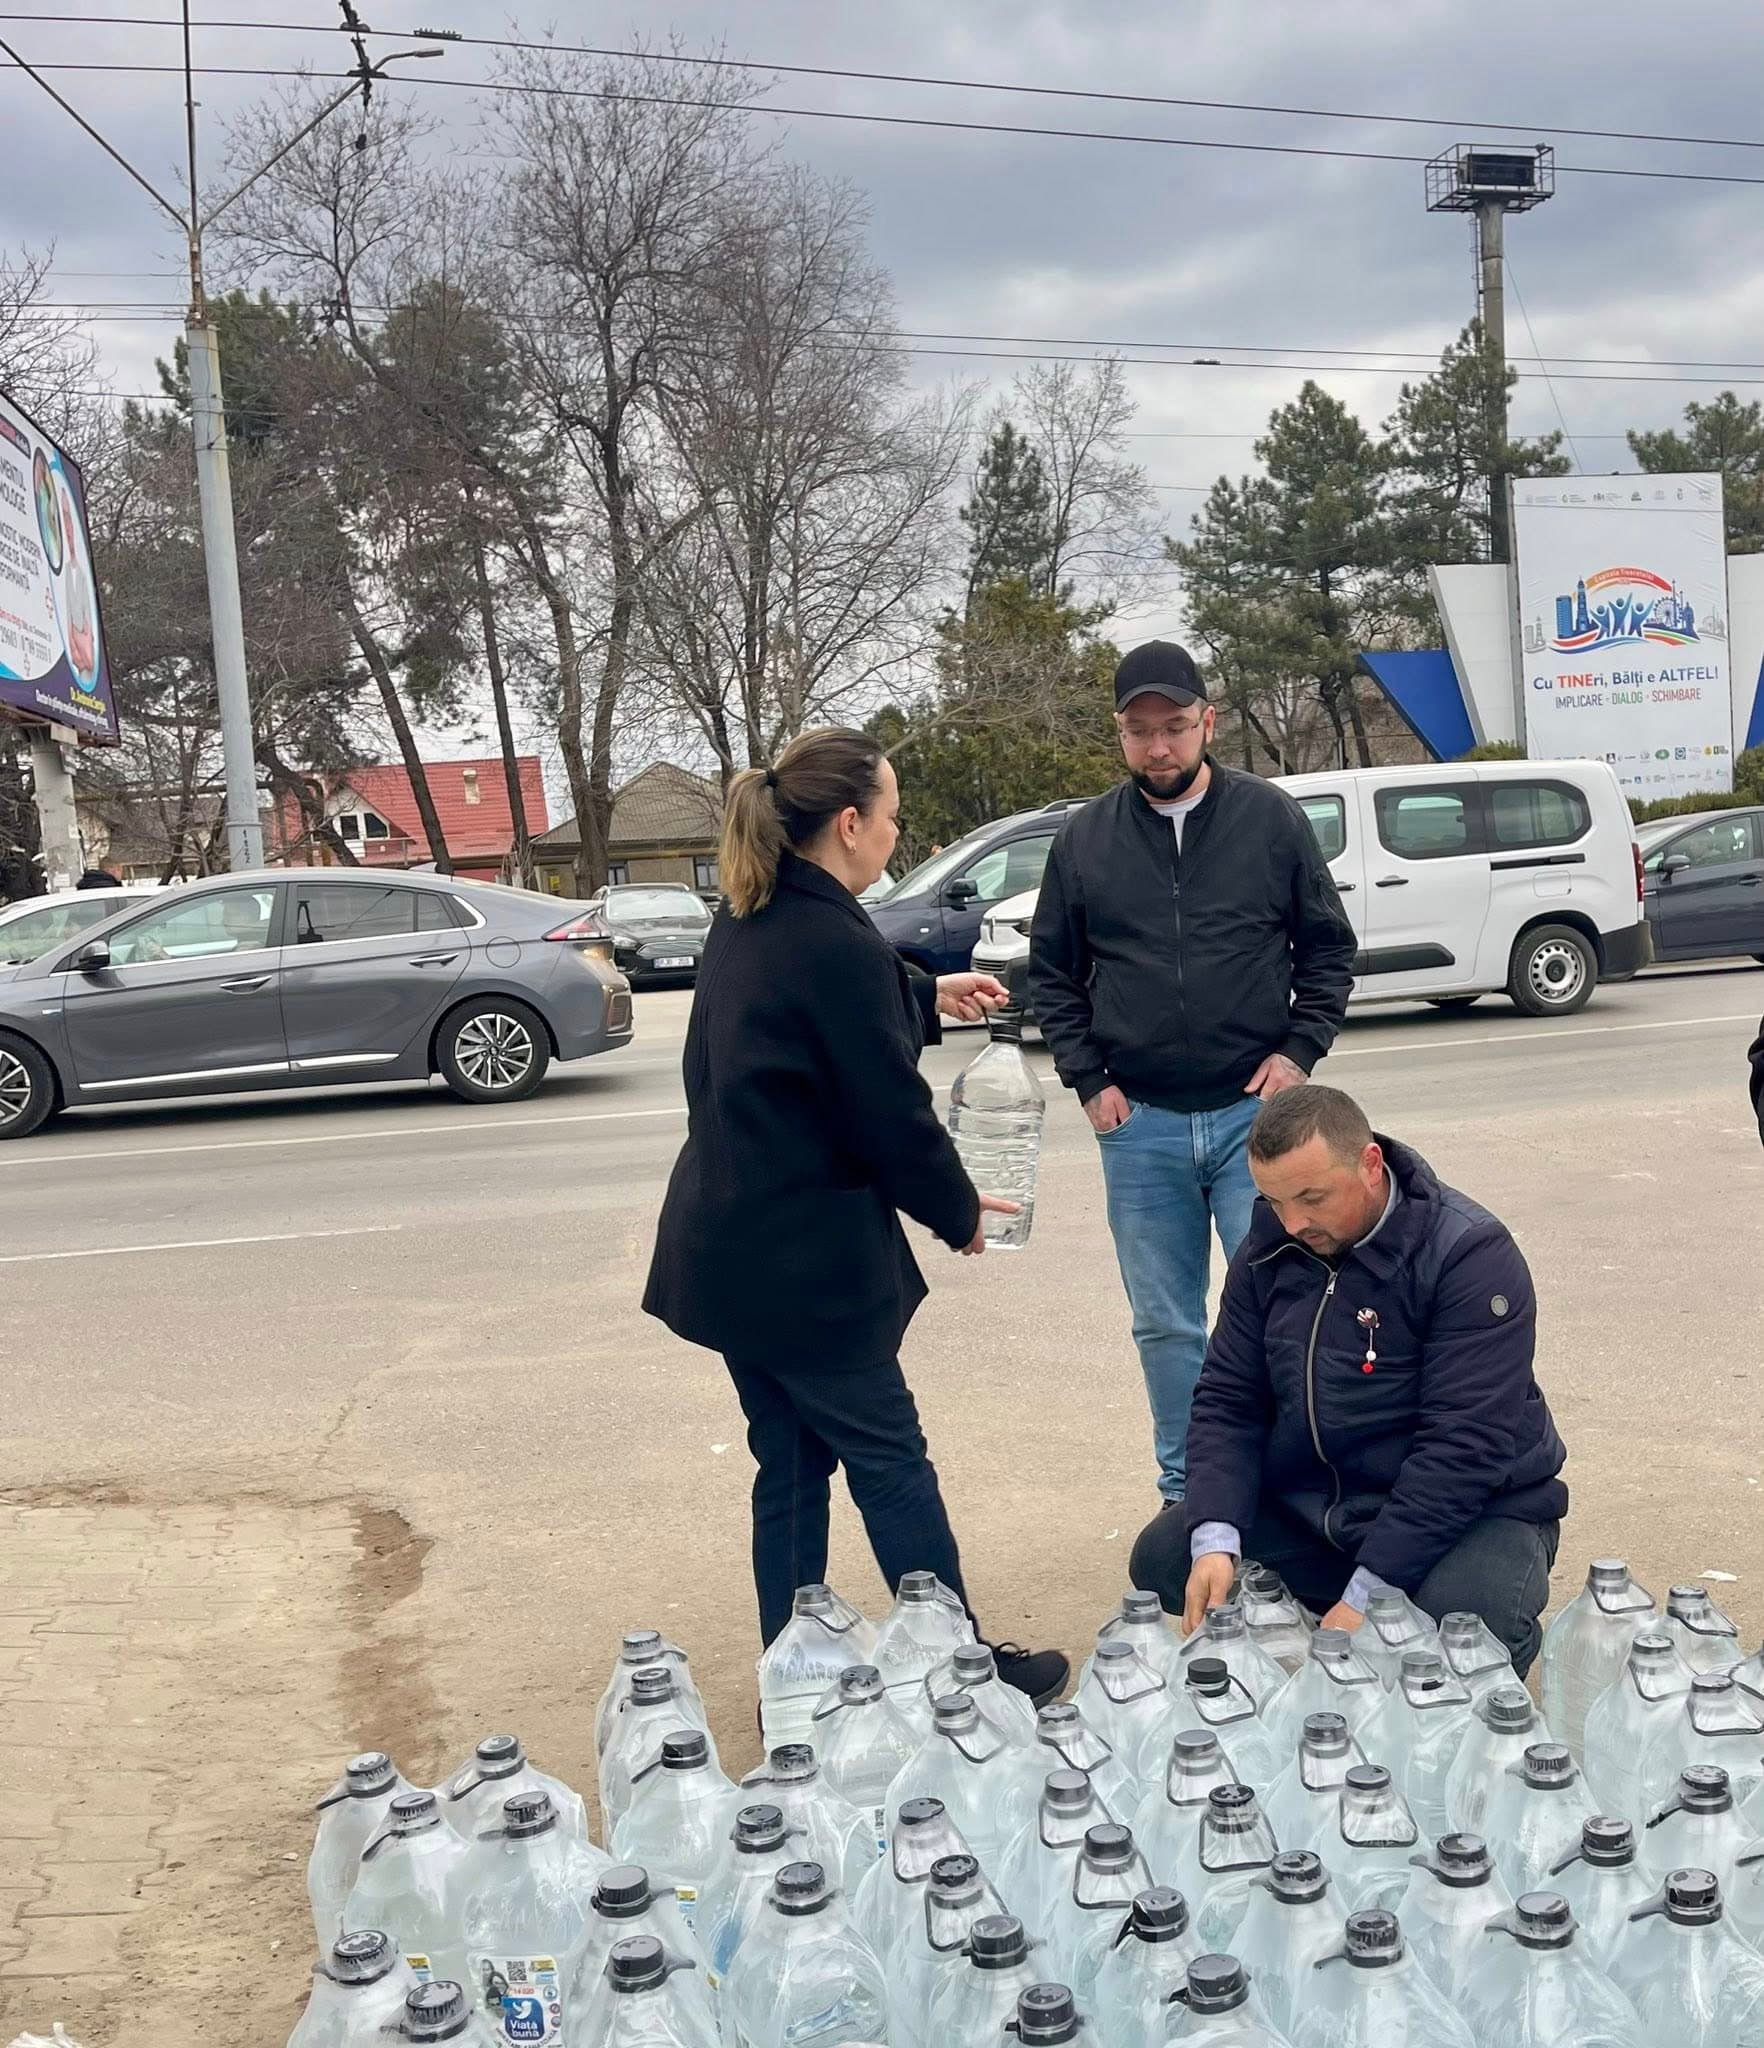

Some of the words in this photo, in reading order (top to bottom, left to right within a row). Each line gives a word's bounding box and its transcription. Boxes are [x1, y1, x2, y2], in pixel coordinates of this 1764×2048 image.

[1533, 677, 1553, 690] Cu
[1557, 673, 1608, 689] TINEri,
[1647, 674, 1656, 683] e
[1659, 665, 1719, 682] ALTFEL!
[1555, 694, 1603, 709] IMPLICARE
[1612, 691, 1643, 705] DIALOG
[1652, 687, 1702, 703] SCHIMBARE
